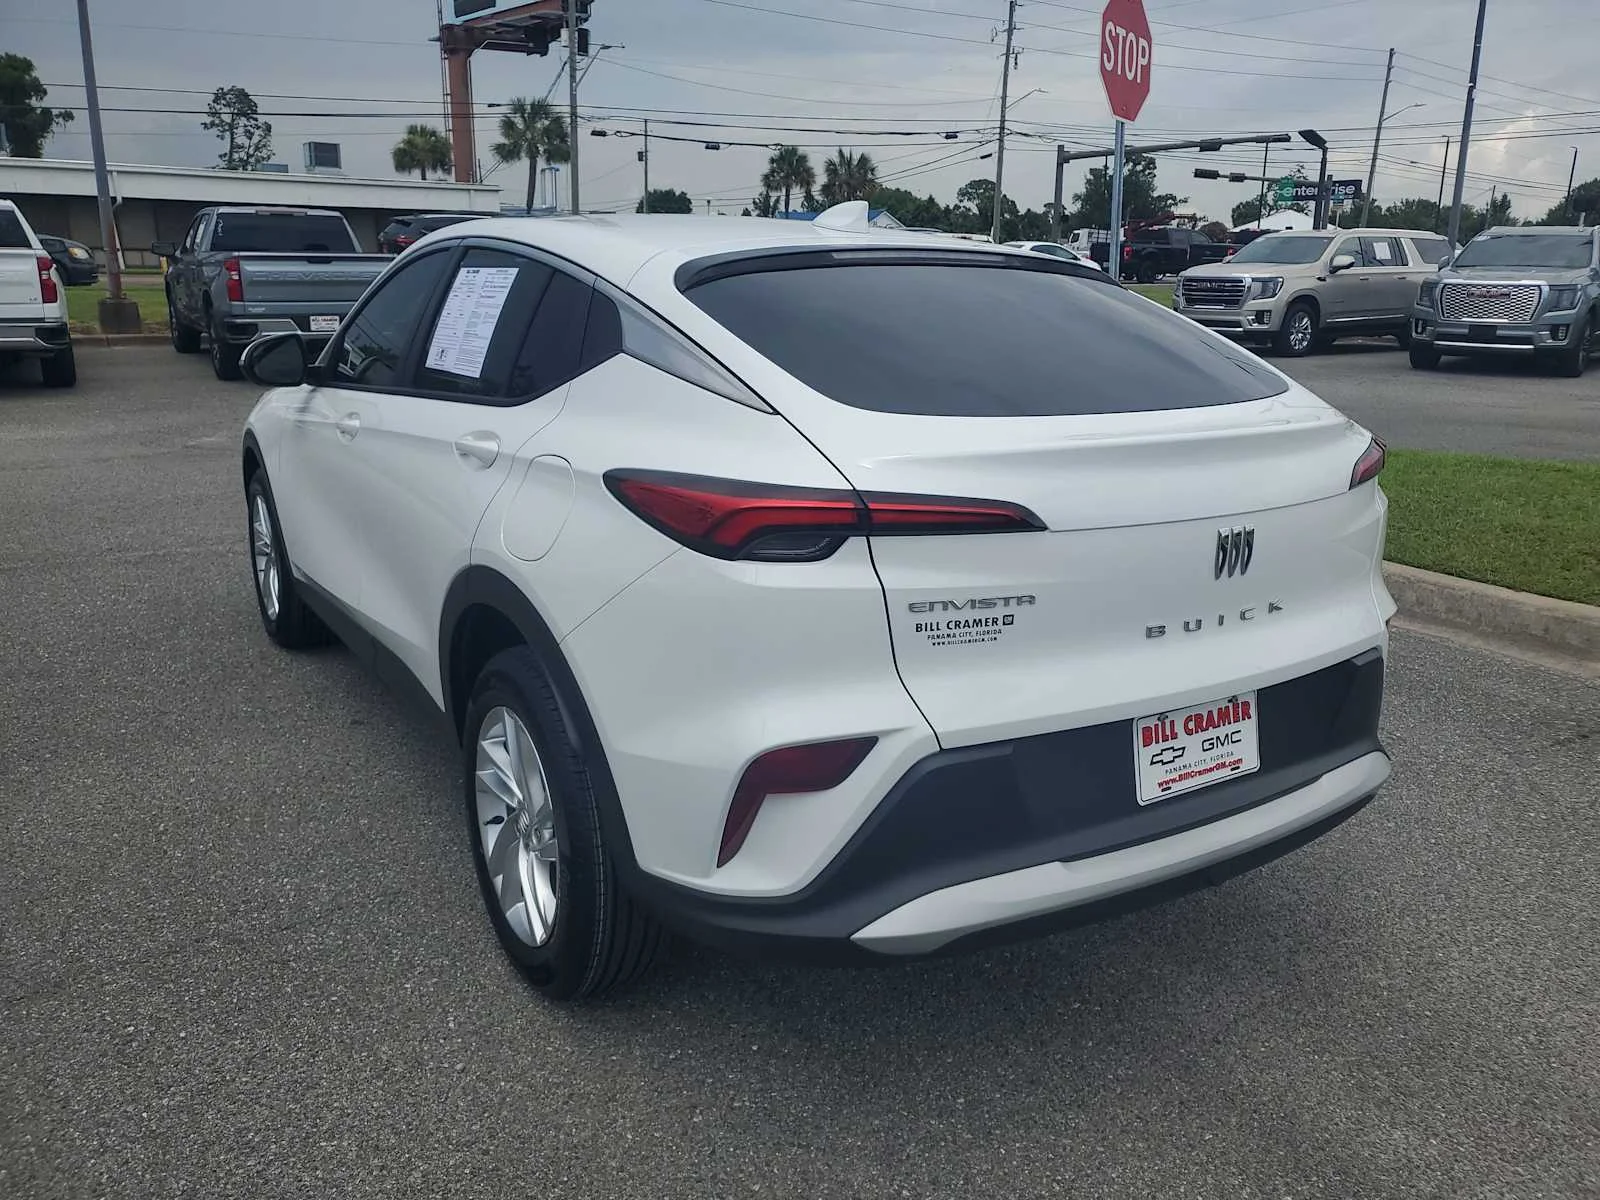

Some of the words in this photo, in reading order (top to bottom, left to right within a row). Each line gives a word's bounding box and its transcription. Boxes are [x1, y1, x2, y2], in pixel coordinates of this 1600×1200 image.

[1103, 21, 1149, 84] STOP
[1279, 183, 1355, 198] enterrise
[908, 595, 1036, 613] ENVISTA
[915, 621, 942, 633] BILL
[946, 616, 999, 631] CRAMER
[1146, 599, 1283, 639] BUICK
[927, 632, 957, 640] PANAMA
[975, 628, 1002, 637] FLORIDA
[1142, 719, 1178, 748] BILL
[1183, 700, 1252, 736] CRAMER
[1201, 729, 1242, 752] GMC
[1157, 758, 1242, 789] www.BillCramerGM.com
[1165, 762, 1192, 775] PANAMA
[1210, 750, 1234, 762] FLORIDA
